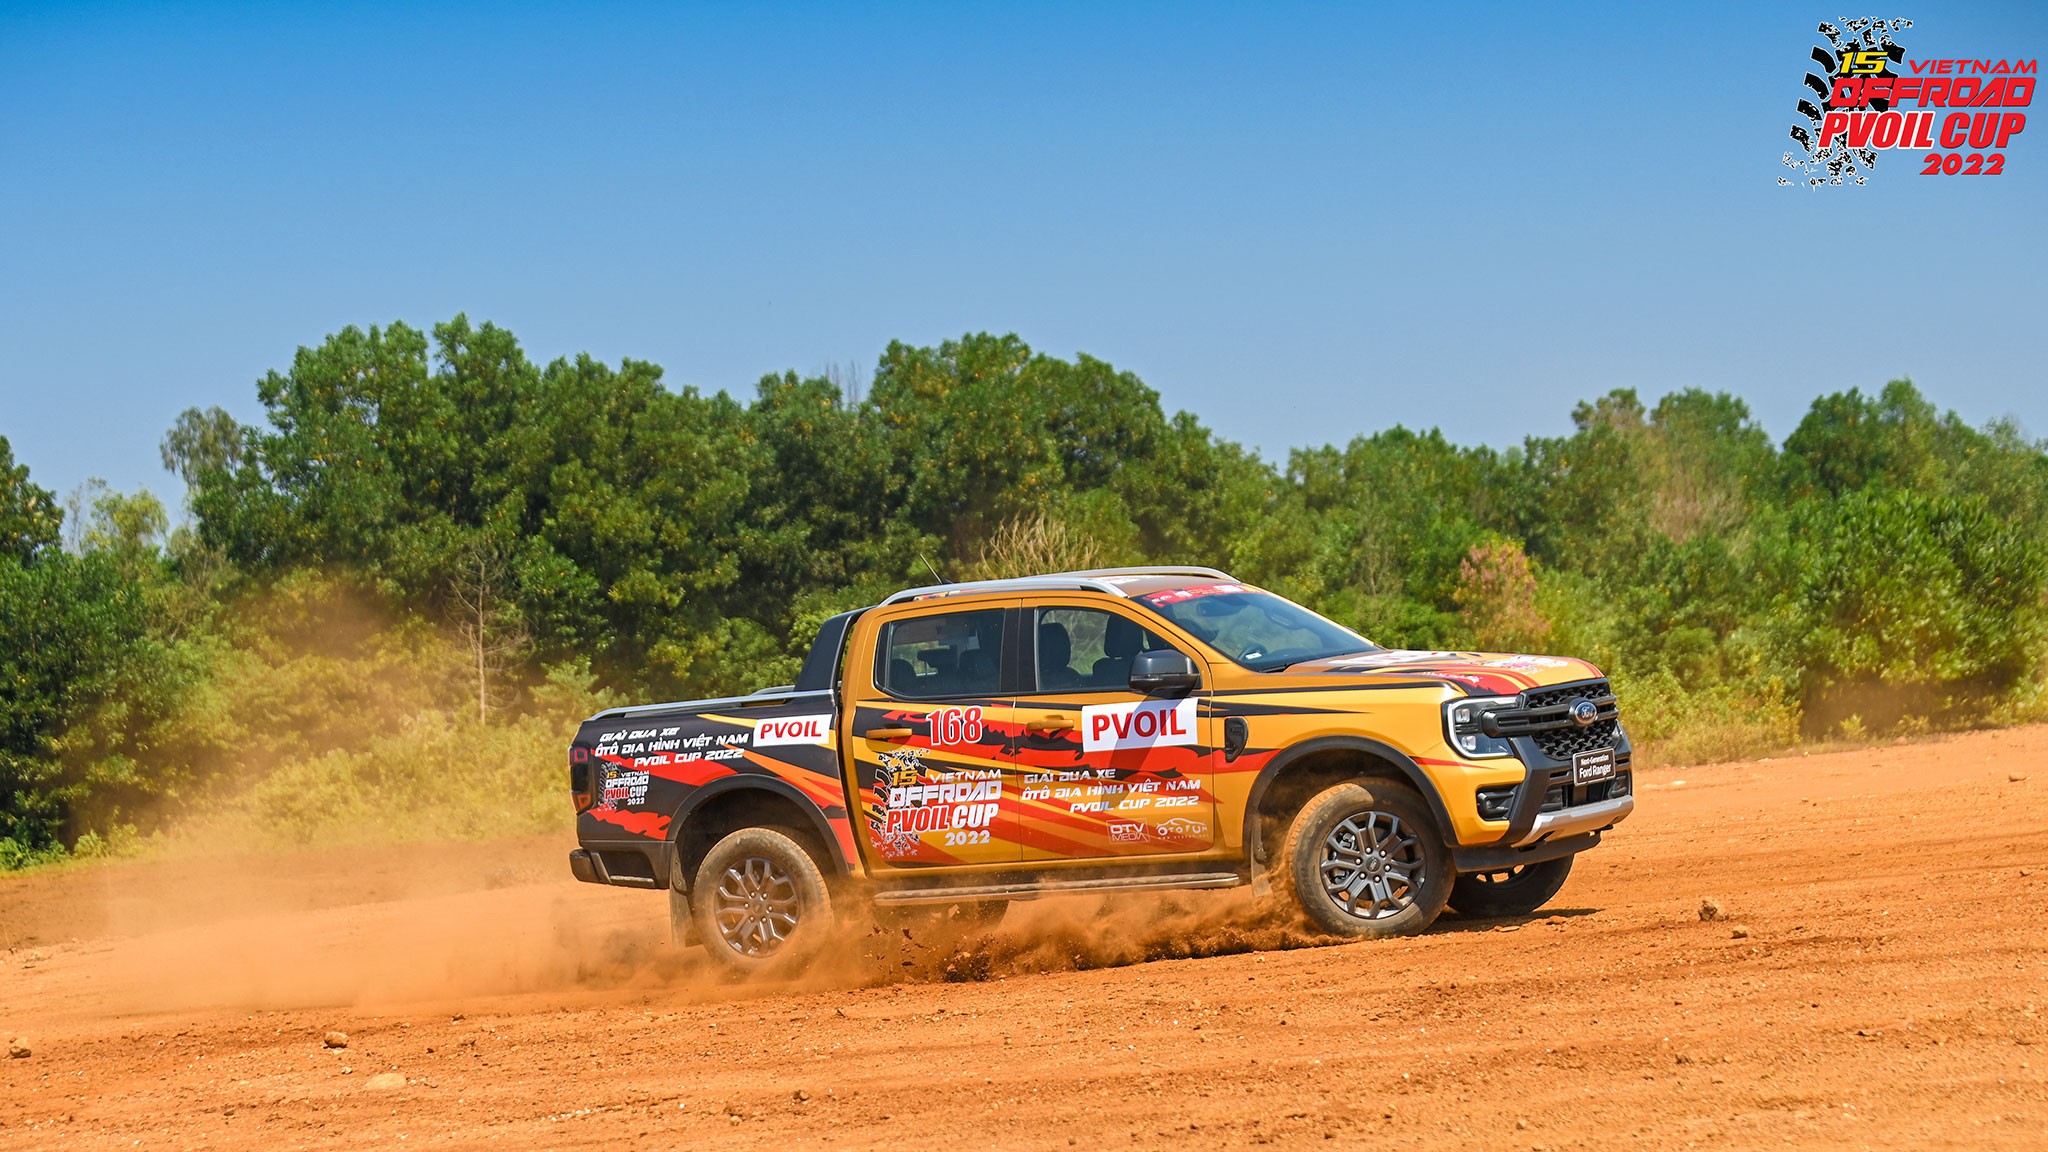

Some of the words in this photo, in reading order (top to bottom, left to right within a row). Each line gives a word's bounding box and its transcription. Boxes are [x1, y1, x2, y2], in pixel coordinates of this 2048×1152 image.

[660, 726, 680, 737] XE
[760, 720, 822, 740] PVOIL
[925, 705, 984, 746] 168
[1092, 709, 1187, 741] PVOIL
[594, 742, 619, 757] ÔTÔ
[648, 736, 680, 752] HÌNH
[683, 733, 713, 750] VIỆT
[716, 733, 749, 746] NAM
[634, 755, 671, 767] PVOIL
[674, 752, 701, 763] CUP
[704, 748, 745, 761] 2022
[606, 771, 618, 779] 15
[620, 770, 649, 778] VIETNAM
[893, 769, 918, 787] 15
[930, 769, 1002, 783] VIETNAM
[1095, 769, 1117, 779] XE
[1580, 766, 1592, 778] Ford
[1593, 764, 1611, 776] Ranger
[605, 776, 649, 788] OFFROAD
[1021, 786, 1051, 801] ÔTÔ
[1086, 781, 1124, 796] HÌNH
[1127, 778, 1161, 797] VIỆT
[1166, 779, 1201, 791] NAM
[604, 787, 629, 800] PVOIL
[629, 785, 648, 798] CUP
[889, 780, 1002, 808] OFFROAD
[627, 797, 645, 806] 2022
[1069, 801, 1114, 813] PVOIL
[1118, 798, 1151, 810] CUP
[1154, 795, 1200, 808] 2022
[885, 805, 950, 835] PVOIL
[952, 803, 999, 828] CUP
[945, 830, 990, 846] 2022
[1111, 833, 1149, 841] MEDIA
[1157, 824, 1208, 836] OTOFUN
